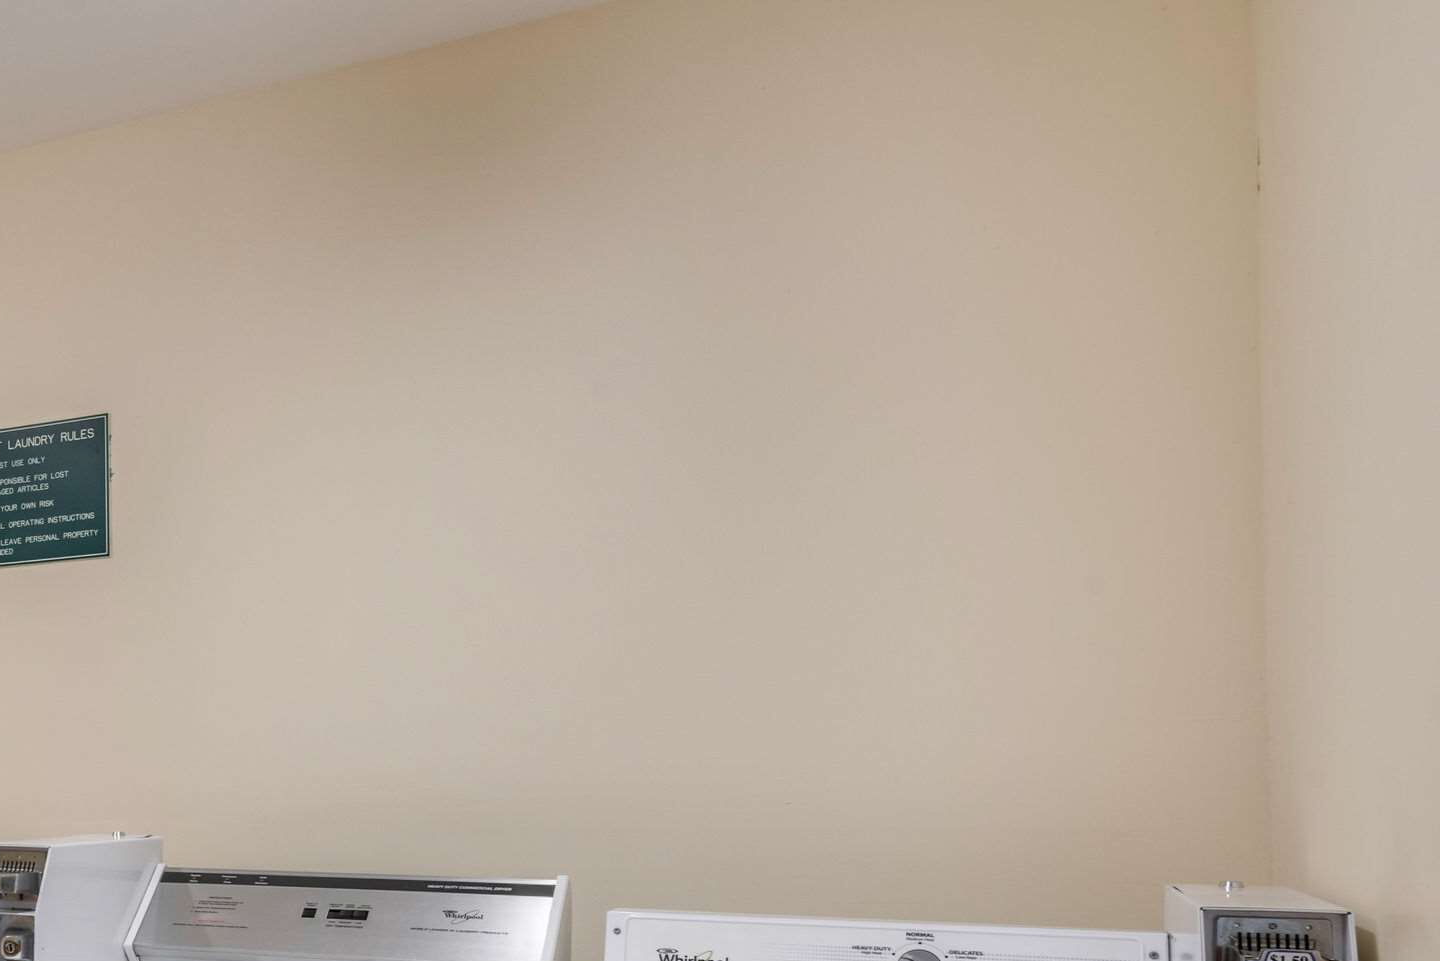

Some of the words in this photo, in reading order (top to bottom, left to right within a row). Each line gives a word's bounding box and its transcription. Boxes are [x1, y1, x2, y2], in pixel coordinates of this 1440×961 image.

[8, 433, 55, 450] LAUNDRY
[60, 428, 95, 442] RULES
[11, 459, 24, 467] USE
[27, 456, 45, 465] ONLY
[34, 473, 47, 481] FOR
[50, 470, 69, 479] LOST
[17, 483, 49, 493] ARTICLES
[0, 504, 17, 512] YOUR
[21, 502, 36, 510] OWN
[8, 518, 45, 528] OPERATING
[47, 512, 95, 524] INSTRUCTIONS
[0, 538, 22, 546] LEAVE
[25, 534, 60, 544] PERSONAL
[63, 529, 99, 539] PROPERTY
[444, 911, 484, 921] Whirlpool
